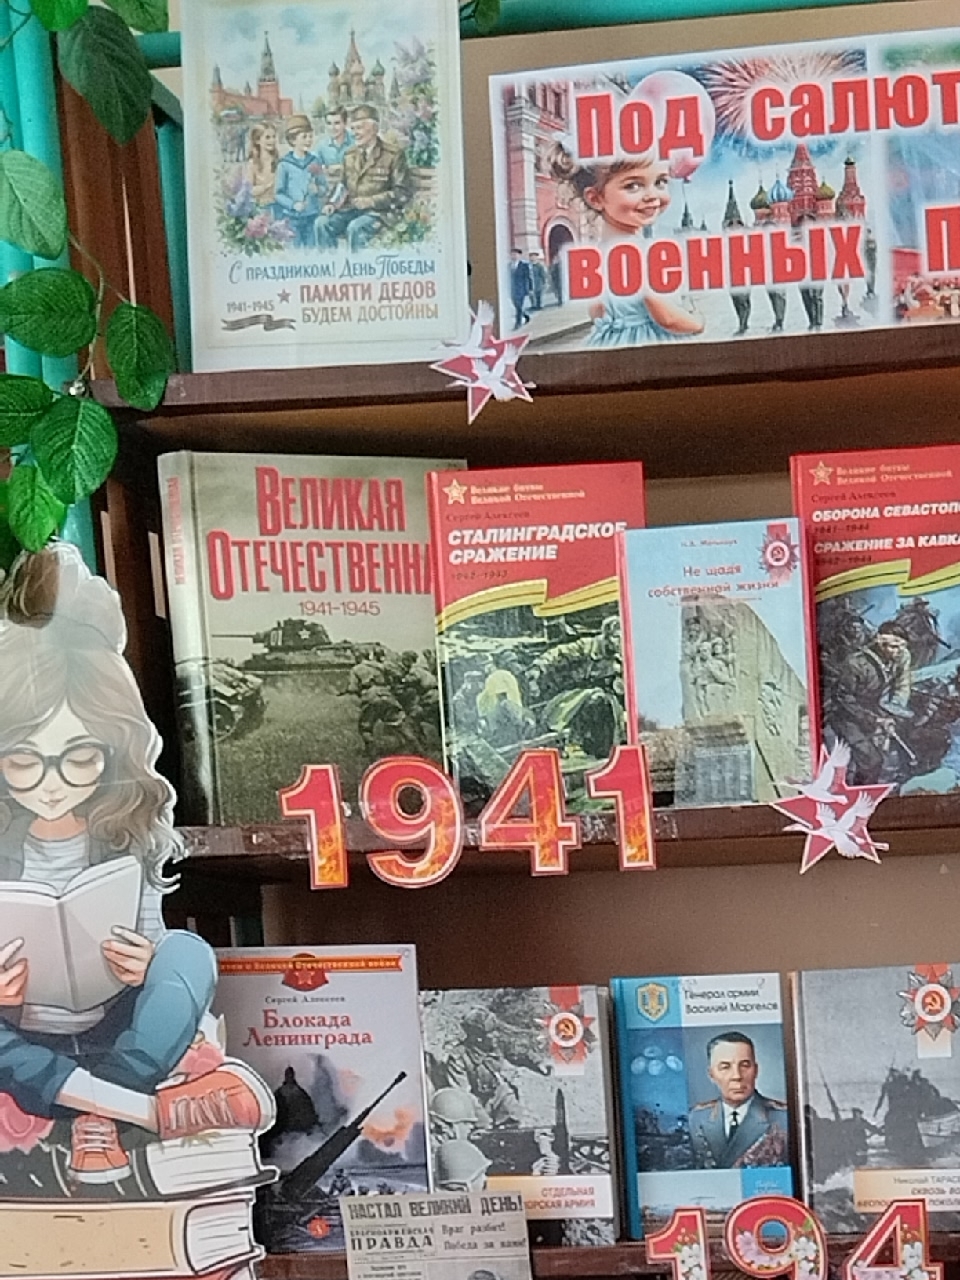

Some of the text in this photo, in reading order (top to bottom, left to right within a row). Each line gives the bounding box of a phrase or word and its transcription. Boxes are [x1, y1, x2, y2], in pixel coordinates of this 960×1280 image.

[575, 90, 704, 160] Под
[229, 261, 242, 284] С
[566, 224, 866, 300] военных
[300, 281, 436, 302] ПАМЯТИ ДЕДОВ
[302, 303, 438, 325] БУДЕМ ДОСТОЙНЫ
[255, 467, 406, 536] ВЕЛИКАЯ
[812, 506, 880, 522] ОБОРОНА
[449, 545, 558, 565] СРАЖЕНИЕ
[815, 537, 893, 553] СРАЖЕНИЕ
[896, 536, 914, 549] ЗА
[207, 531, 432, 600] ОТЕЧЕСТВЕНН
[683, 566, 701, 577] Не
[277, 745, 657, 890] 1941
[263, 1009, 351, 1029] Блокада
[243, 1027, 373, 1050] Ленинграда
[542, 1187, 595, 1198] ОТДЕЛЬНАЯ
[348, 1195, 523, 1219] НАСТАЛ ВЕЛИКИЙ ДЕНЬ!
[351, 1235, 433, 1251] ПРАВДА
